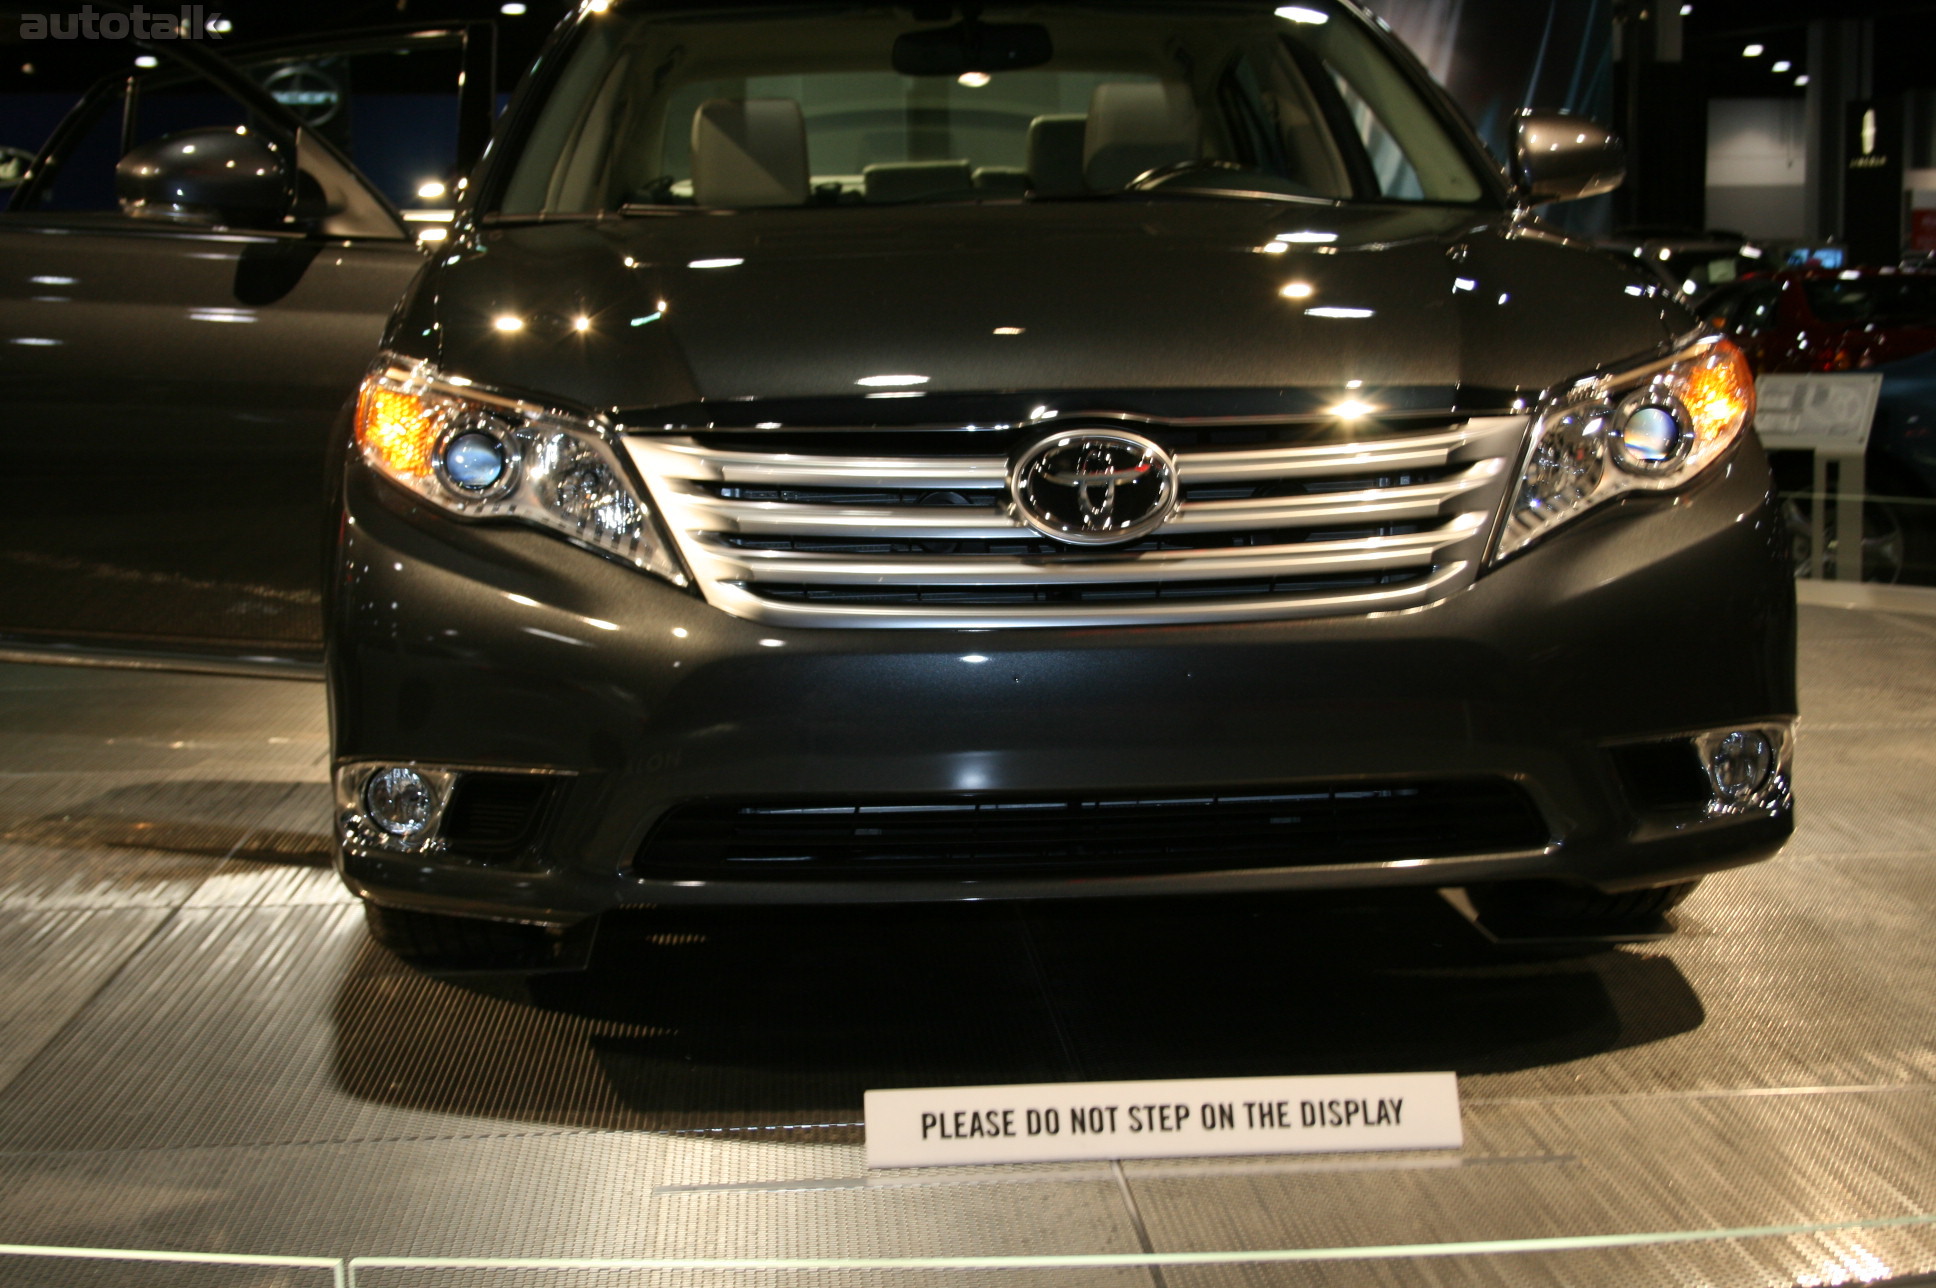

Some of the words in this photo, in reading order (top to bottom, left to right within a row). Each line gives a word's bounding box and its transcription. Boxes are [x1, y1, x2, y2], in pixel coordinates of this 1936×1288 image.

[921, 1109, 1017, 1140] PLEASE
[1026, 1108, 1060, 1136] DO
[1070, 1106, 1118, 1135] NOT
[1128, 1104, 1190, 1133] STEP
[1200, 1103, 1235, 1131] ON
[1243, 1101, 1291, 1129] THE
[1300, 1098, 1403, 1128] DISPLAY
